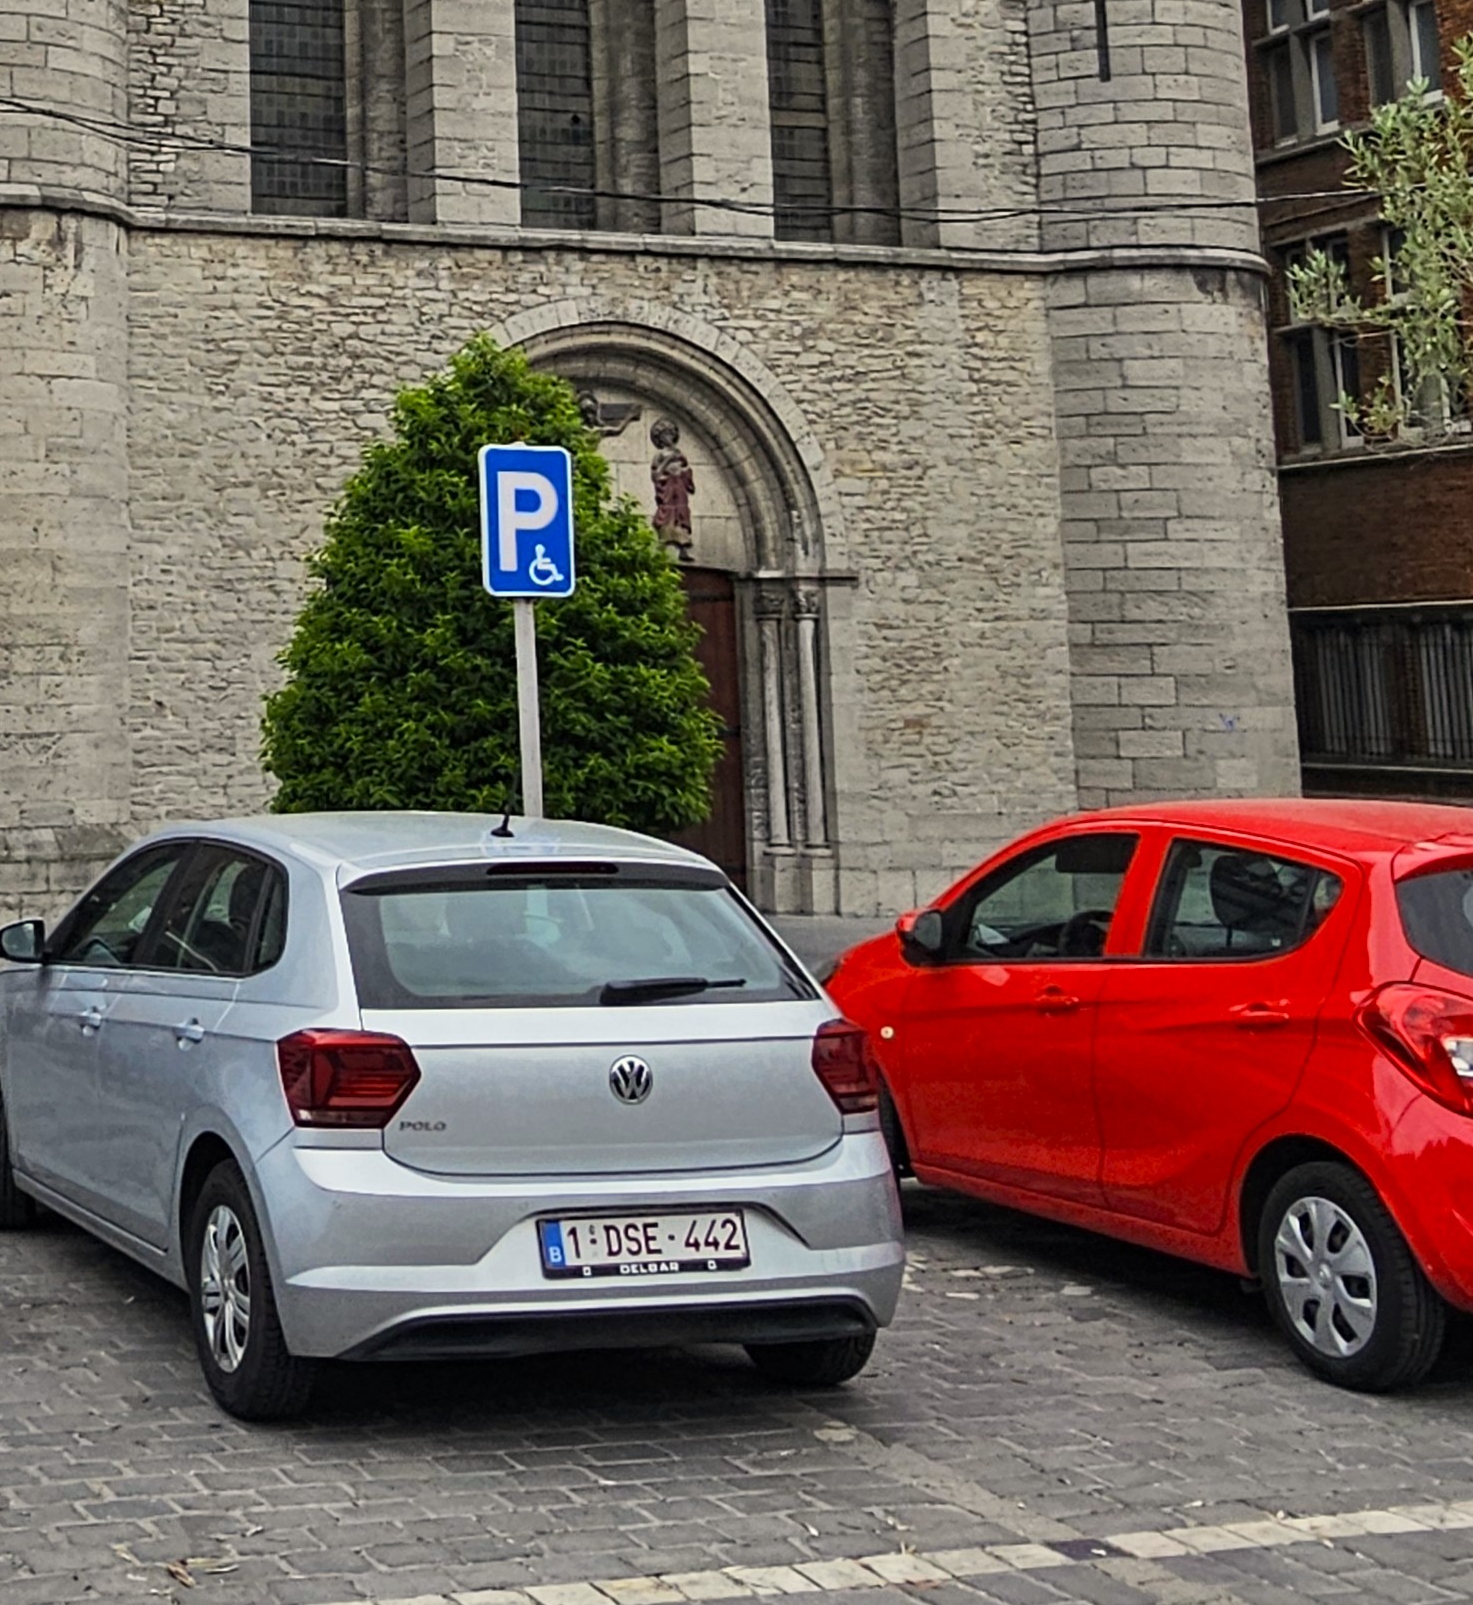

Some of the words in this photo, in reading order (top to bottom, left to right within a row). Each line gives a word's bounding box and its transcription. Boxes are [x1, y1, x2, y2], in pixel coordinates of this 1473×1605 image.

[497, 471, 559, 572] P
[399, 1120, 447, 1132] POLO
[549, 1246, 562, 1263] B
